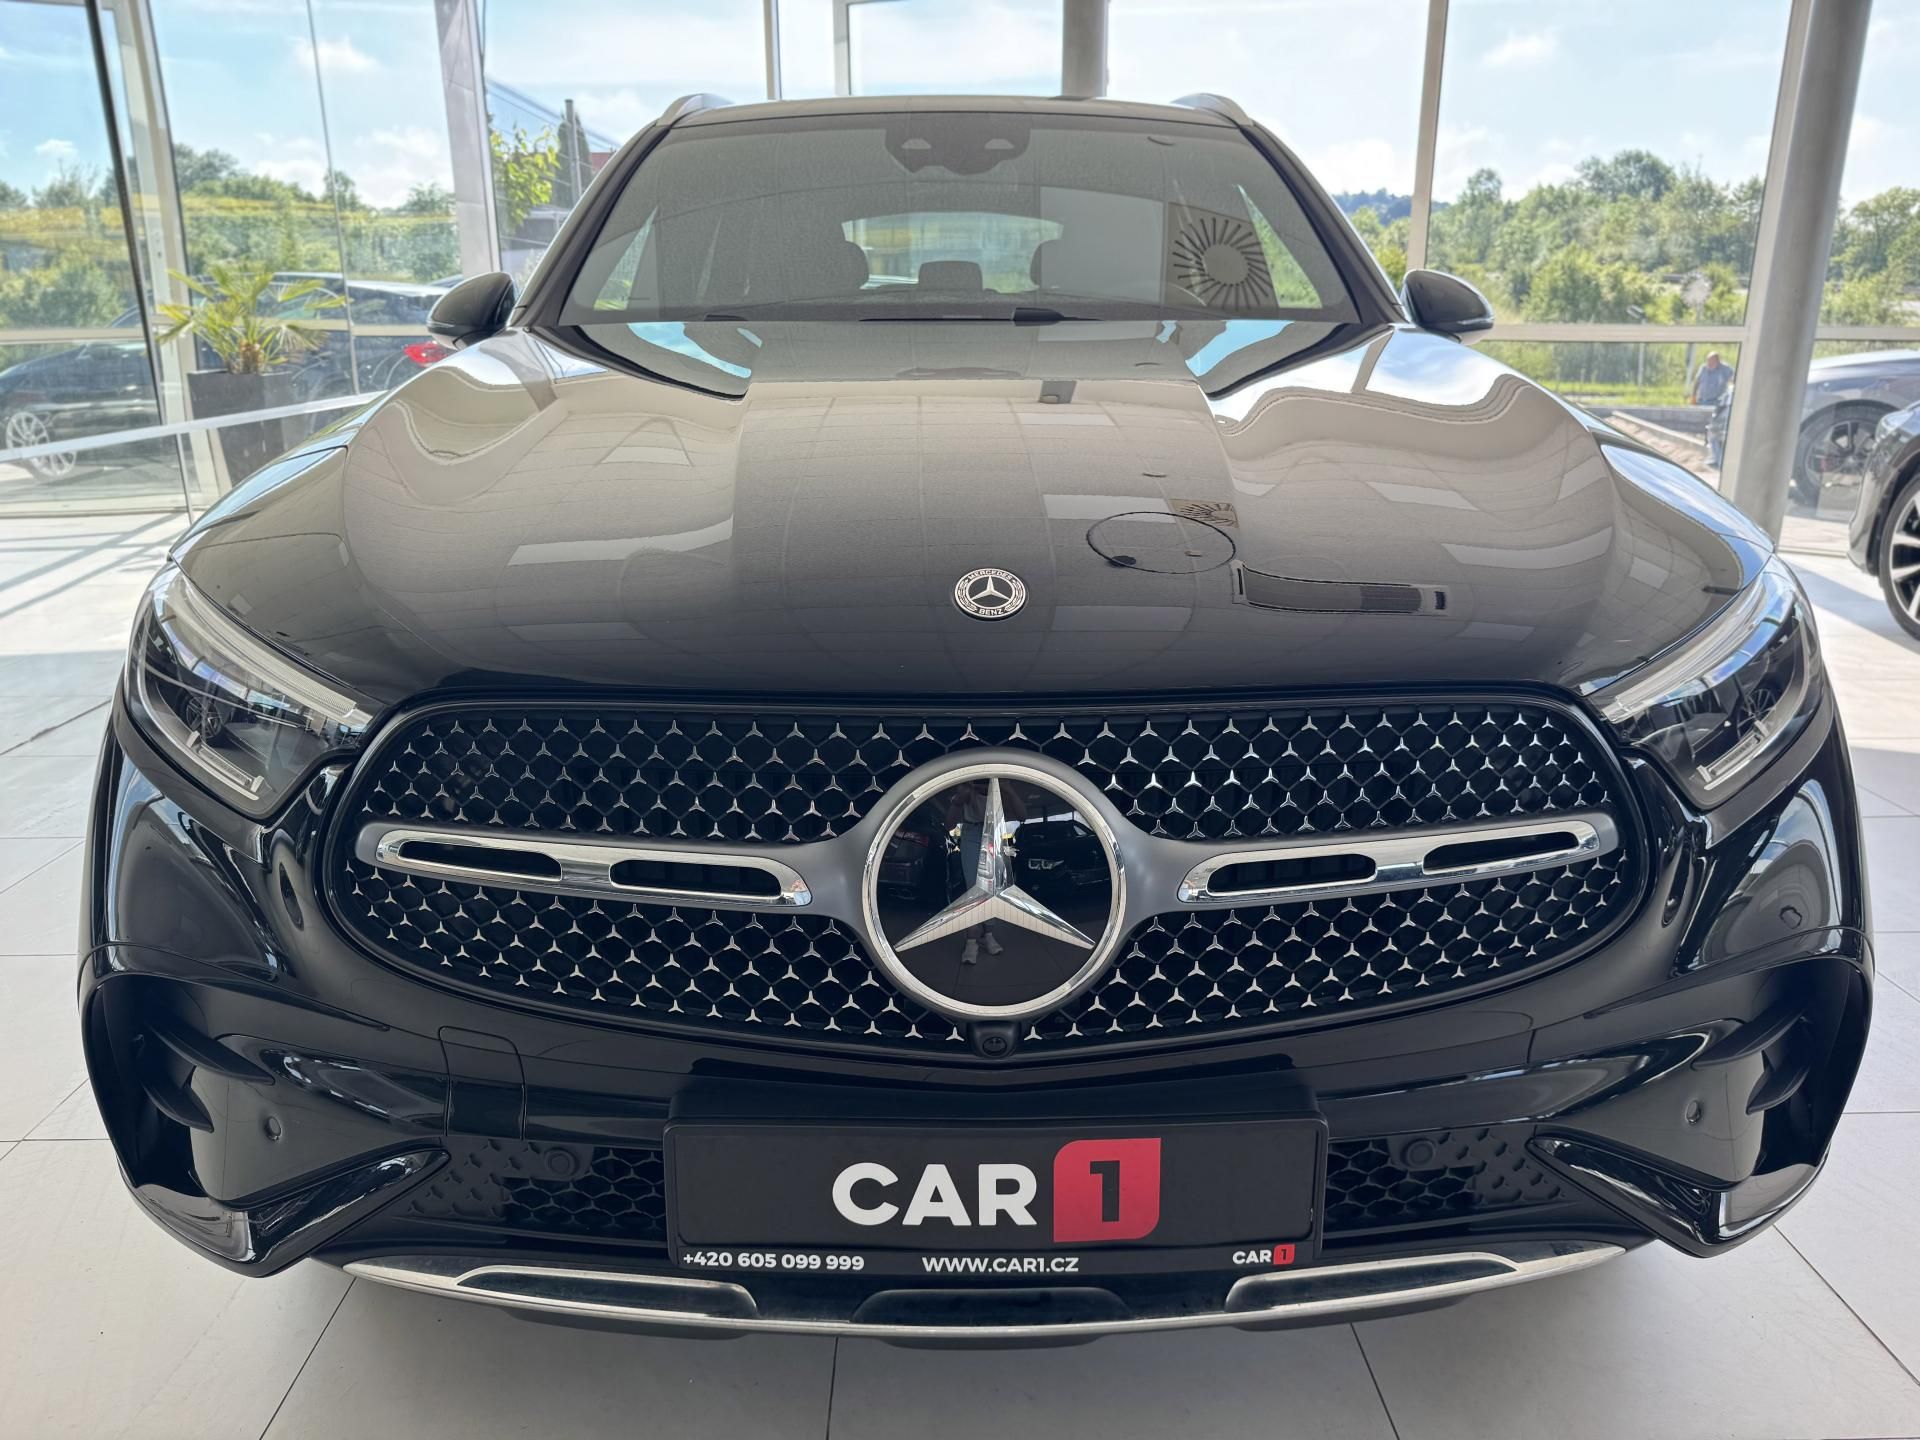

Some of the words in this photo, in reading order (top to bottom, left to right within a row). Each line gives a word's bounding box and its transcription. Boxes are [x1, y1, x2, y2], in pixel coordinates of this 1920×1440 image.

[967, 569, 1013, 580] MERCEDES
[978, 608, 1004, 616] BENZ
[832, 1162, 1038, 1226] CAR
[1089, 1160, 1121, 1223] 1
[683, 1251, 733, 1267] +420
[737, 1252, 777, 1268] 605
[781, 1254, 821, 1270] 099
[825, 1255, 865, 1271] 999
[921, 1257, 1079, 1273] WWW.CAR1.CZ
[1232, 1249, 1272, 1265] CAR
[1280, 1249, 1288, 1261] 1
